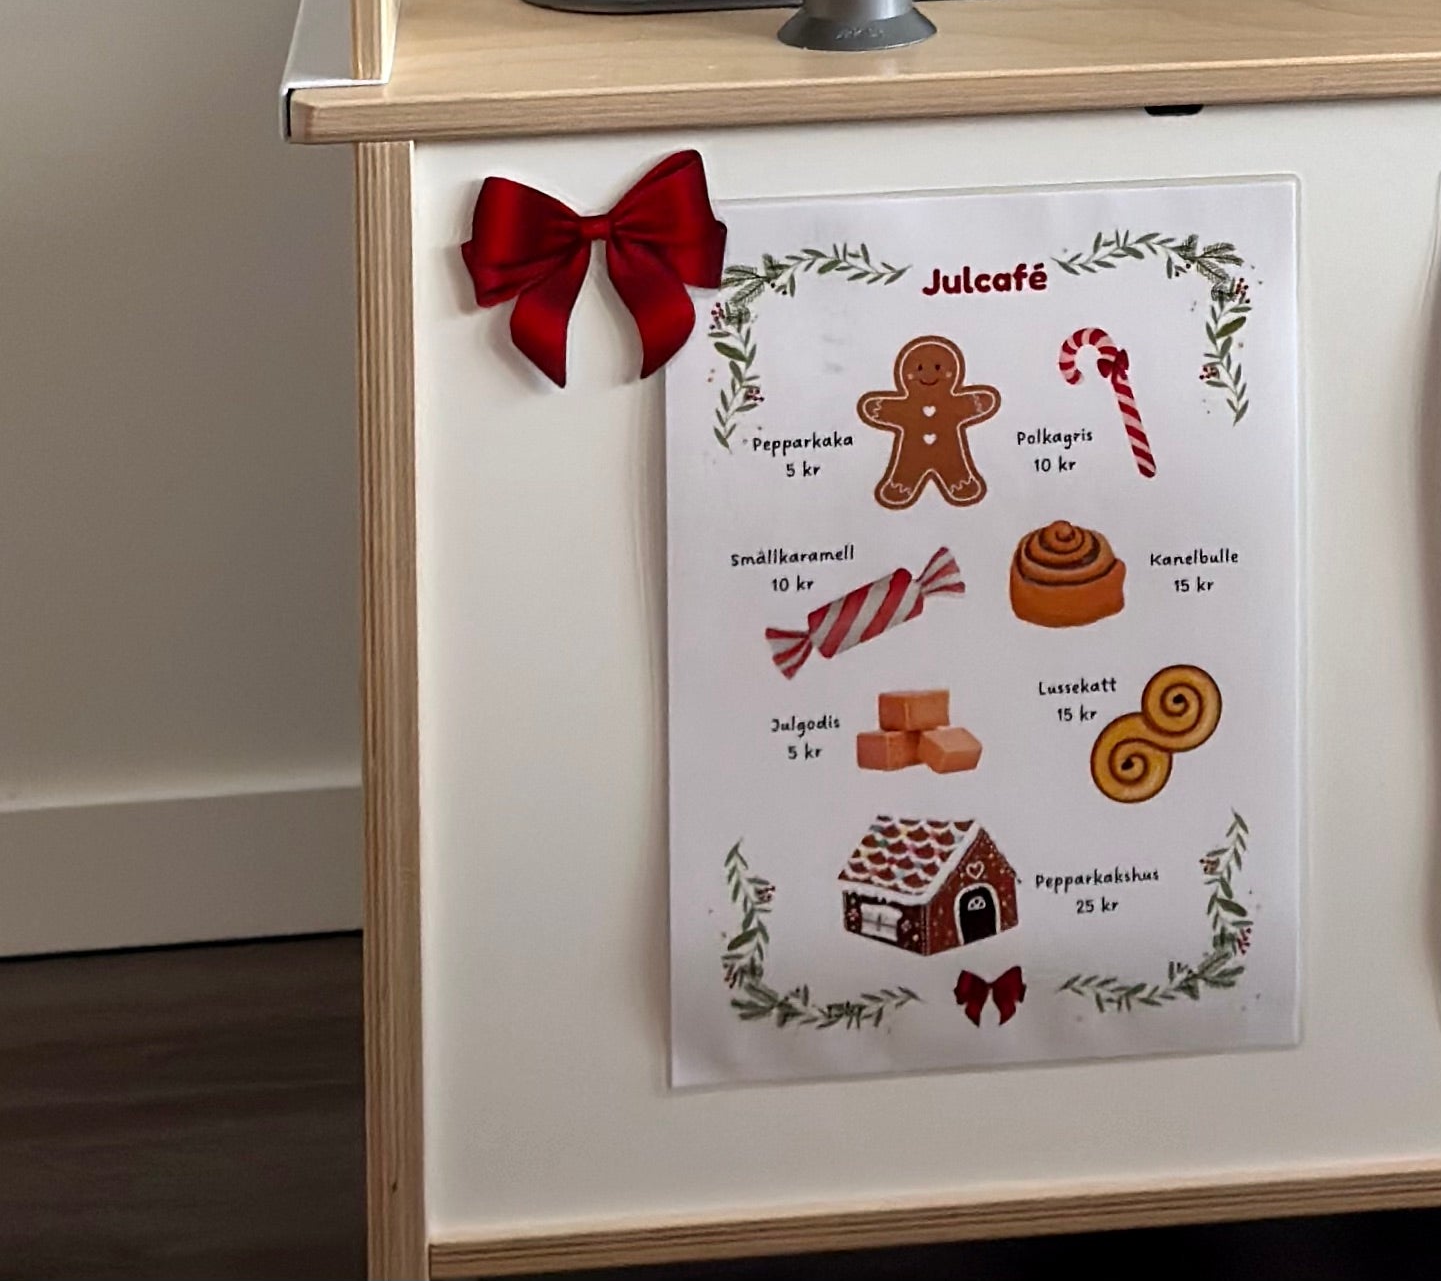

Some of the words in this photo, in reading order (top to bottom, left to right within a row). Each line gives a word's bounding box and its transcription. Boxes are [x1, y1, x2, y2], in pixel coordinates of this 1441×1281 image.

[921, 261, 1048, 297] Julcafé
[752, 430, 854, 454] Pepparkaka
[1016, 427, 1093, 449] Polkagris
[785, 462, 796, 478] 5
[802, 459, 821, 478] kr
[1033, 457, 1052, 473] 10
[1057, 455, 1077, 473] kr
[1149, 547, 1239, 567] Kanelbulle
[771, 577, 790, 593] 10
[796, 574, 815, 592] kr
[1173, 578, 1190, 593] 15
[1196, 575, 1215, 593] kr
[1038, 677, 1117, 696] Lussekatt
[1057, 707, 1074, 722] 15
[1079, 703, 1098, 723] kr
[771, 714, 841, 738] Julgodis
[787, 745, 798, 760] 5
[804, 742, 823, 761] kr
[1035, 865, 1160, 893] Pepparkakshus
[1076, 899, 1095, 915] 25
[1101, 895, 1120, 914] kr
